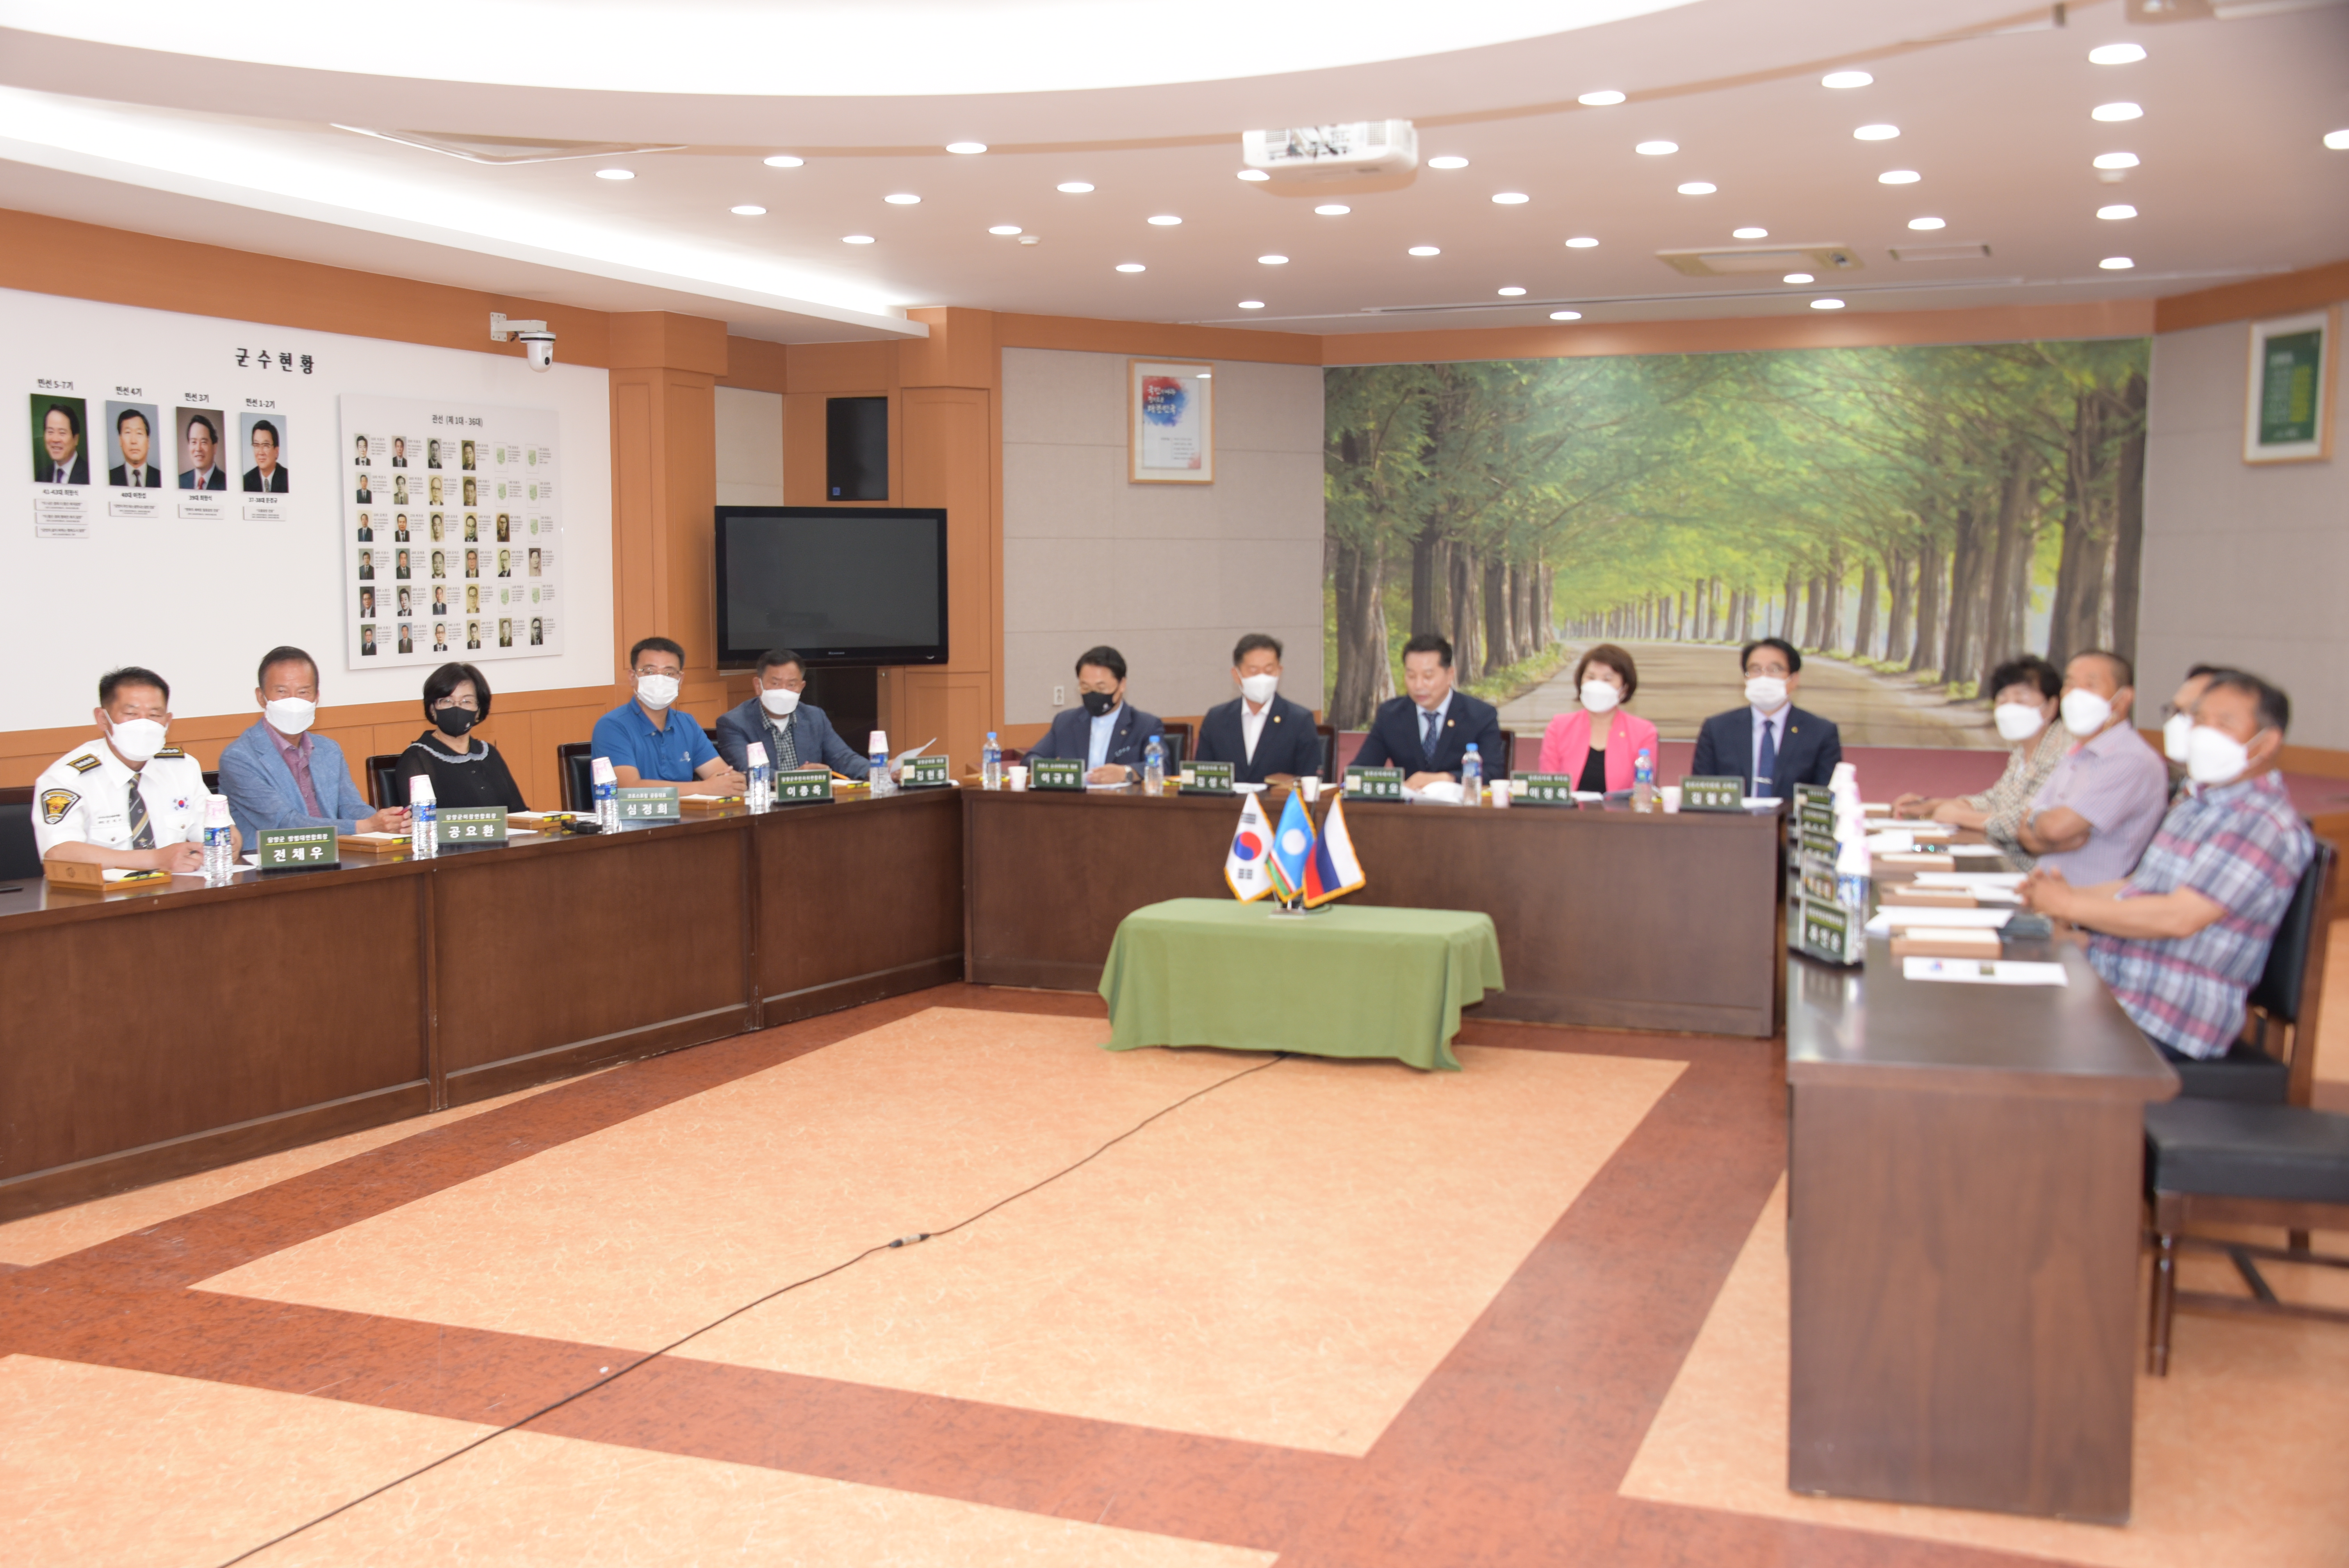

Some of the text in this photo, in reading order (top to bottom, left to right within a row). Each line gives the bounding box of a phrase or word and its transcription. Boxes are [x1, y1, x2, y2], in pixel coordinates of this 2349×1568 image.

[38, 379, 74, 390] 민선 5-7기
[116, 387, 142, 397] 민선 4기
[185, 393, 209, 403] 민선 3기
[246, 399, 275, 409] 민선 1-2기
[433, 415, 444, 424] 관선
[447, 416, 454, 425] (제
[456, 417, 464, 426] 1대
[469, 418, 483, 428] 36대)
[627, 803, 667, 815] 심정희
[445, 812, 497, 821] 담양군이장연합회장
[448, 824, 495, 839] 공요환
[267, 835, 285, 844] 담양군
[274, 846, 323, 862] 전채우
